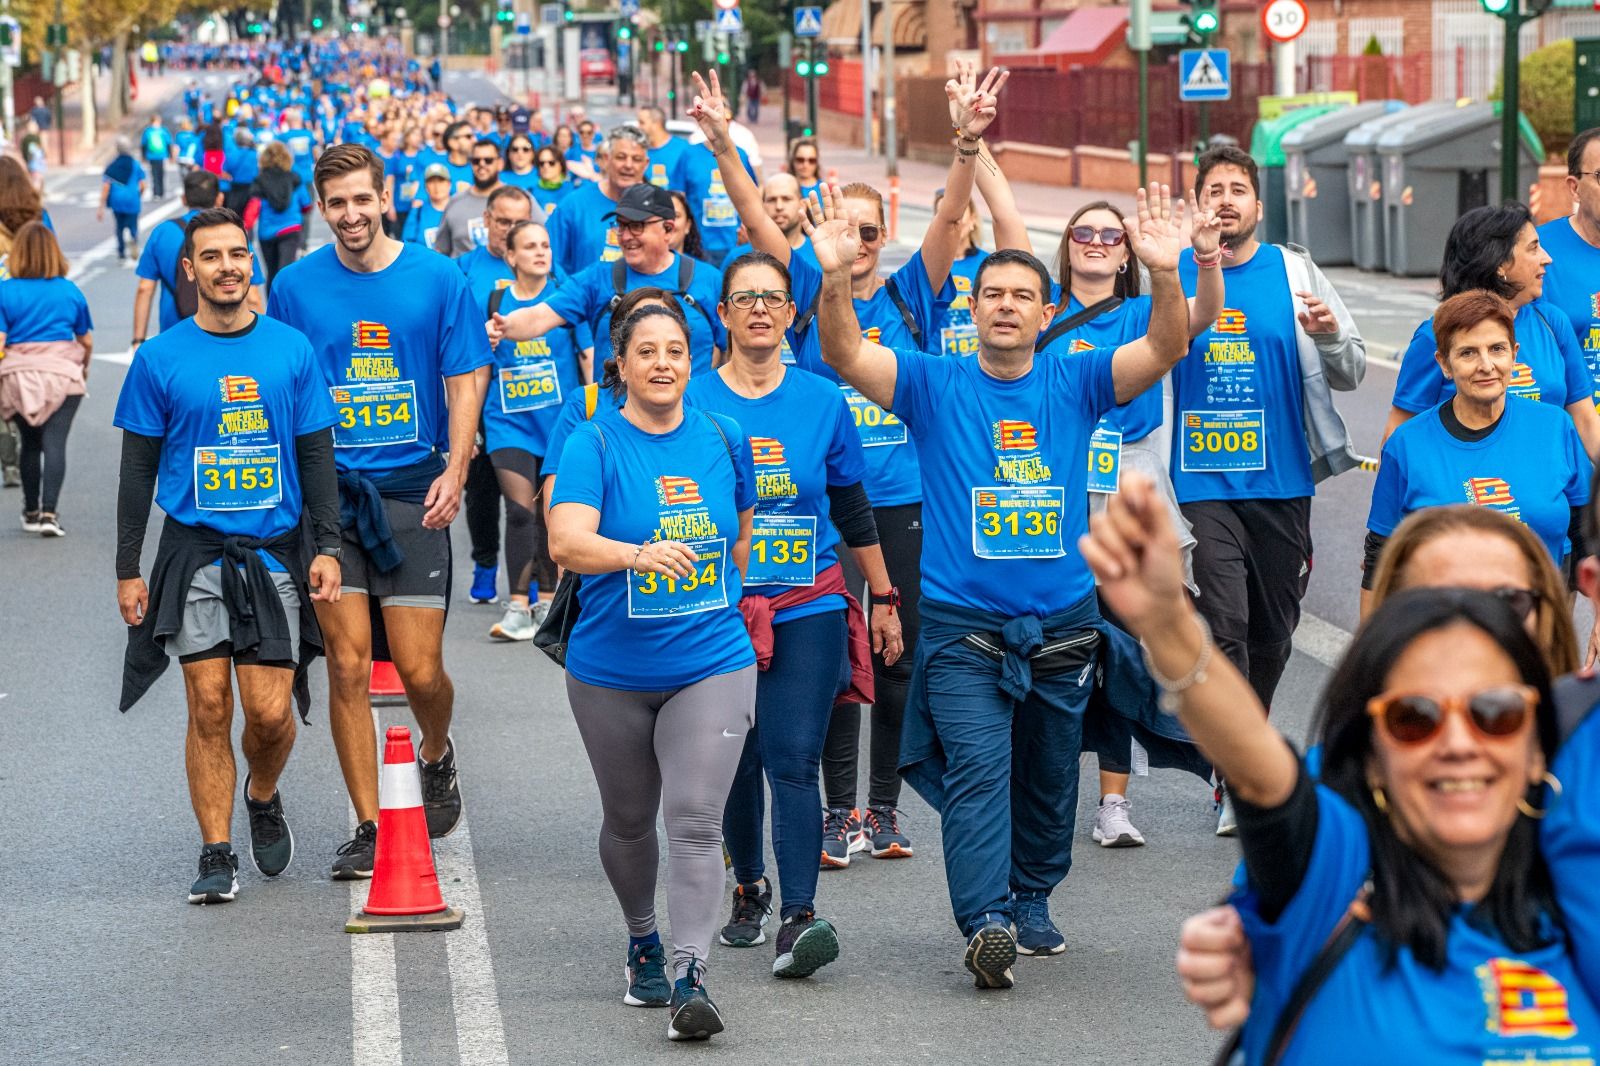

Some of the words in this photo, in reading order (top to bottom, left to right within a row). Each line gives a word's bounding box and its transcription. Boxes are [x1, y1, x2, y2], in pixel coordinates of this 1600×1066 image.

[1274, 11, 1298, 25] 30
[948, 338, 979, 353] 182
[1209, 338, 1249, 352] MUÉVETE
[352, 355, 393, 368] MUÉVETE
[1204, 352, 1210, 362] X
[1213, 351, 1255, 362] VALENCIA
[346, 368, 352, 378] X
[354, 367, 400, 378] VALENCIA
[506, 377, 554, 398] 3026
[222, 408, 263, 424] MUÉVETE
[340, 402, 411, 428] 3154
[218, 424, 225, 434] X
[226, 419, 269, 433] VALENCIA
[1190, 431, 1258, 452] 3008
[999, 456, 1042, 468] MUÉVETE
[1088, 451, 1114, 473] 19
[204, 467, 273, 490] 3153
[995, 466, 1001, 479] X
[1002, 465, 1051, 481] VALENCIA
[660, 512, 710, 529] MUÉVETE
[983, 512, 1058, 536] 3136
[654, 529, 662, 541] X
[665, 523, 718, 540] VALENCIA
[784, 528, 812, 536] VALENCIA
[752, 540, 808, 563] 135
[639, 563, 717, 594] 3134
